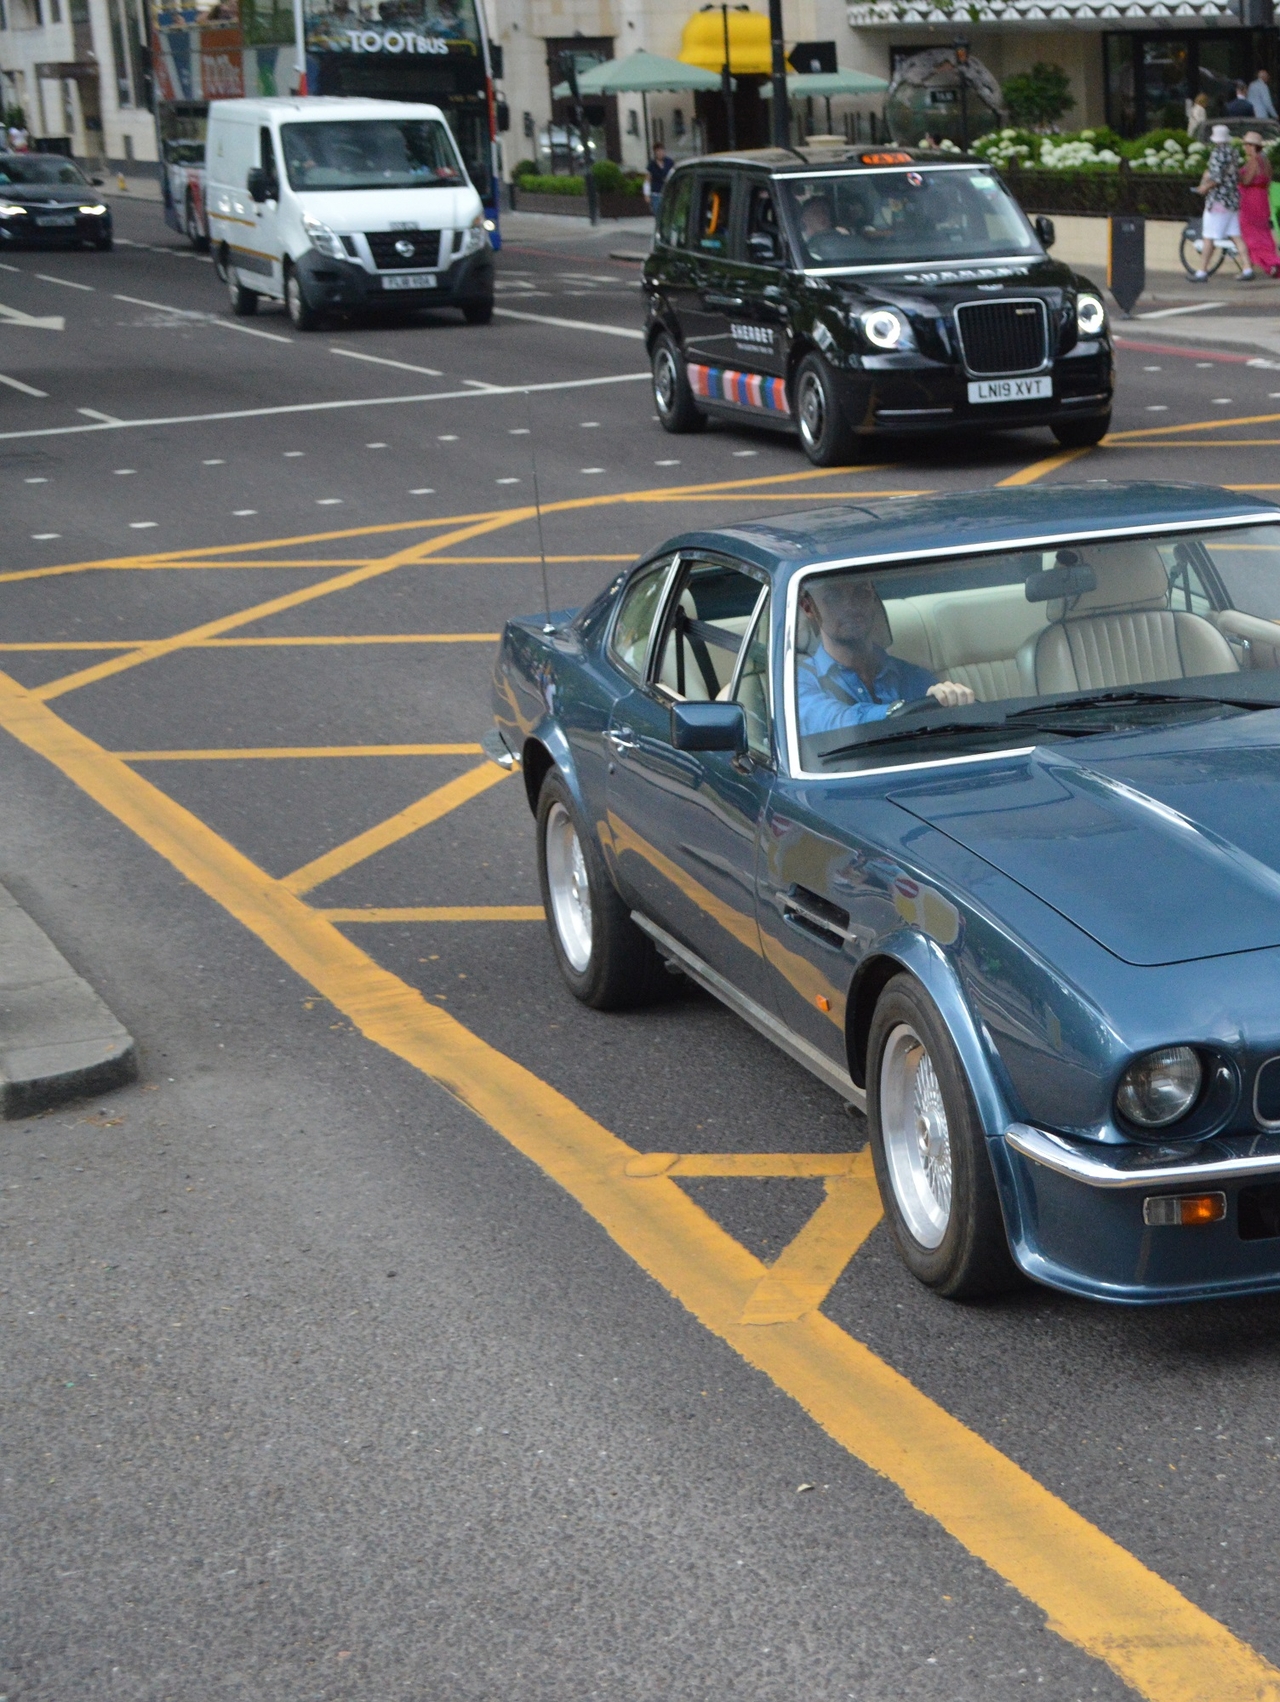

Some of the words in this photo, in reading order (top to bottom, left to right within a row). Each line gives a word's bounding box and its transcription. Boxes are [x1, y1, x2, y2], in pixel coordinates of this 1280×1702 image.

[345, 29, 449, 55] TOOTBUS
[730, 323, 774, 344] SHERBET
[979, 382, 1011, 398] LN19
[1015, 380, 1042, 396] XVT
